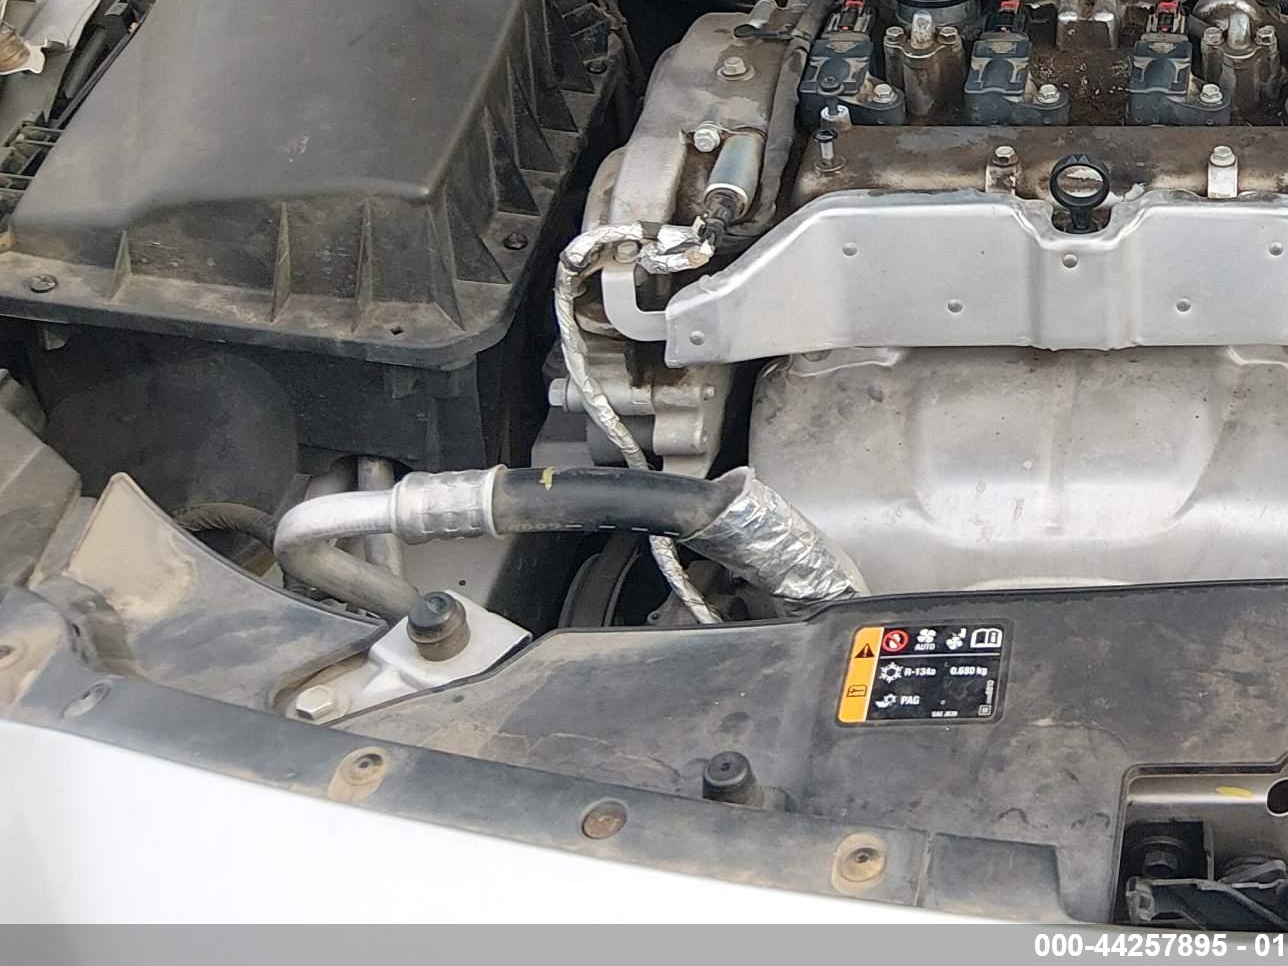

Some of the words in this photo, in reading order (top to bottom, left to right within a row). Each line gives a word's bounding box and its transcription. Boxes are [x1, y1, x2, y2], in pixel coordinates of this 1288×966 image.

[914, 643, 936, 651] AUTO
[904, 666, 937, 676] R-134a
[976, 666, 988, 677] kg
[900, 695, 921, 705] PAG
